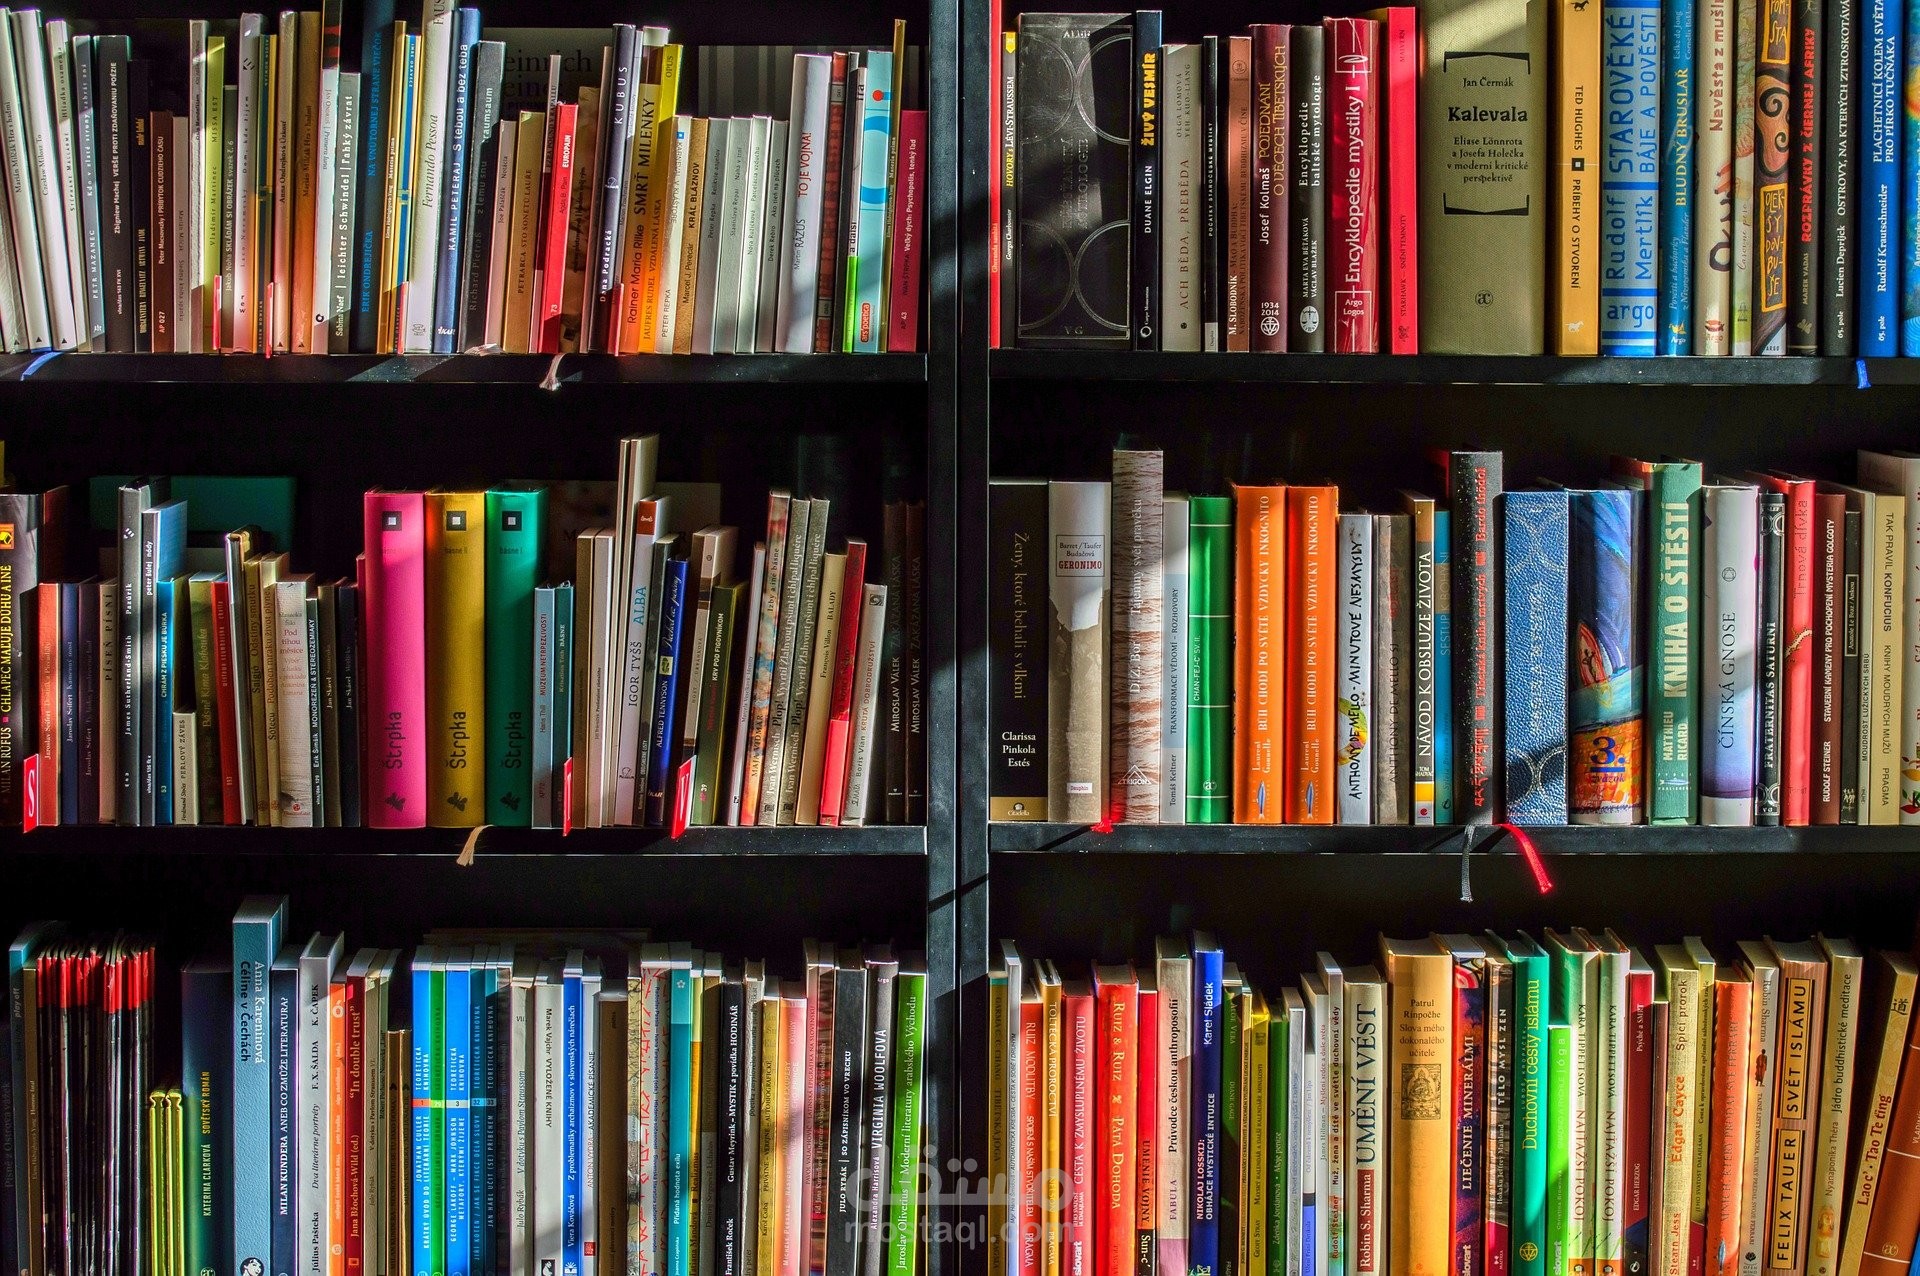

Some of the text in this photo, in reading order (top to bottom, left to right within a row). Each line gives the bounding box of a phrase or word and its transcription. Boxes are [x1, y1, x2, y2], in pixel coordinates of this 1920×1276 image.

[456, 73, 466, 92] bez
[458, 44, 468, 69] teba
[1141, 53, 1155, 108] VESMÍR
[1462, 77, 1514, 88] Jan Čermák
[453, 107, 463, 139] tebou
[614, 66, 628, 124] KUBUS
[1272, 45, 1286, 195] O VĚCECH TIBETSKÝCH
[1448, 106, 1527, 121] Kalevala
[1575, 85, 1583, 150] TED HUGHES
[1606, 14, 1634, 173] STAROVĚKÉ
[1637, 14, 1657, 172] BÁJE A POVĚSTI
[1141, 111, 1155, 145] ŽIVÝ
[1298, 102, 1309, 186] Encyklopedie
[1311, 75, 1322, 186] baltské mytologie
[1346, 96, 1363, 163] mystiky
[1674, 68, 1689, 206] BLUDNÝ BRUSLAŘ
[1801, 28, 1815, 242] ROZPRÁVKY Z ČIERNEJ AFRIKY
[111, 156, 119, 177] VERŠE
[422, 114, 438, 208] Fernando Pessoa
[797, 132, 812, 197] TO JE VOJNA!
[1144, 165, 1152, 195] ELGIN
[1257, 83, 1271, 245] Josef Kolmaš POJEDNÁNÍ
[448, 162, 461, 251] KAMIL PETERAJ
[627, 98, 654, 324] Rainer Maria Rilke SMRŤ MILENKY
[1345, 167, 1362, 282] Encyklopedie
[1570, 179, 1580, 288] PRÍBEHY O STVORENÍ
[1606, 195, 1625, 279] Rudolf
[1635, 196, 1652, 279] Mertlík
[1877, 184, 1888, 292] Rudolf Krautschneider
[1836, 226, 1846, 297] Lucien Deprijck
[1607, 305, 1654, 327] argo
[1259, 496, 1270, 555] INKOGNITO
[1058, 561, 1102, 569] GERONIMO
[1257, 560, 1270, 610] VŽDYCKY
[103, 593, 113, 632] PÍSNÍ
[1661, 502, 1689, 697] KNIHA O ŠTĚSTÍ
[628, 586, 647, 706] IGOR TYŠŠ ALBA
[1170, 588, 1179, 734] TRANSFORMACE VĚDOMÍ ROZHOVORY
[1260, 651, 1269, 665] PO
[1416, 552, 1432, 756] NÁVOD K OBSLUZE ŽIVOTA
[1257, 670, 1269, 705] CHODÍ
[1718, 612, 1735, 748] ČÍNSKÁ GNOSE
[1764, 622, 1776, 768] FRATERNITAS SATURNI
[379, 712, 405, 769] Štrpka
[446, 712, 469, 769] Štrpka
[1002, 731, 1036, 740] Clarissa
[1002, 745, 1036, 753] Pinkola
[1008, 757, 1030, 766] Estés
[1663, 711, 1673, 760] MATTHIEU
[1677, 723, 1688, 760] RICARD
[280, 998, 288, 1057] LITERATURA?
[1074, 1016, 1086, 1054] ŽIVOTU
[1204, 982, 1214, 1044] Karel Sládek
[1498, 1008, 1506, 1031] ZEN
[1675, 980, 1688, 1051] Spící prorok
[1831, 974, 1851, 1113] Jádro buddhistické meditace
[279, 1059, 287, 1091] ZMŮŽE
[1168, 999, 1179, 1152] Průvodce českou anthroposofií
[1498, 1038, 1506, 1069] MYSL
[1523, 980, 1540, 1150] Duchovní cesty islámu
[1785, 985, 1806, 1112] SVĚT ISLÁMU
[281, 1093, 287, 1105] CO
[872, 1029, 886, 1149] VIRGINIA WOOLFOVÁ
[1074, 1059, 1085, 1138] ZMYSLUPLNÉMU
[1352, 1003, 1375, 1164] UMĚNÍ VÉST
[1461, 1036, 1474, 1189] LIEČENIE MINERÁLMI
[201, 1071, 211, 1216] KATERINA CLARKOVÁ SOVĚTSKÝ ROMÁN
[896, 996, 917, 1270] Jaroslav Oliverius Moderní literatury arabského Východu
[1671, 1075, 1685, 1162] Edgar Cayce
[1866, 1140, 1881, 1162] Tao
[1870, 1122, 1883, 1136] Te
[1075, 1155, 1084, 1184] CESTA
[1197, 1140, 1205, 1220] NIKOLAJ LOSSKIJ:
[1205, 1133, 1215, 1177] MYSTICKÉ
[1205, 1180, 1215, 1220] OBHÁJCE
[1361, 1174, 1372, 1267] Robin S. Sharma
[1777, 1138, 1796, 1260] FELIX TAUER
[1857, 1184, 1872, 1206] Lao
[311, 1212, 320, 1272] Július Pašteka
